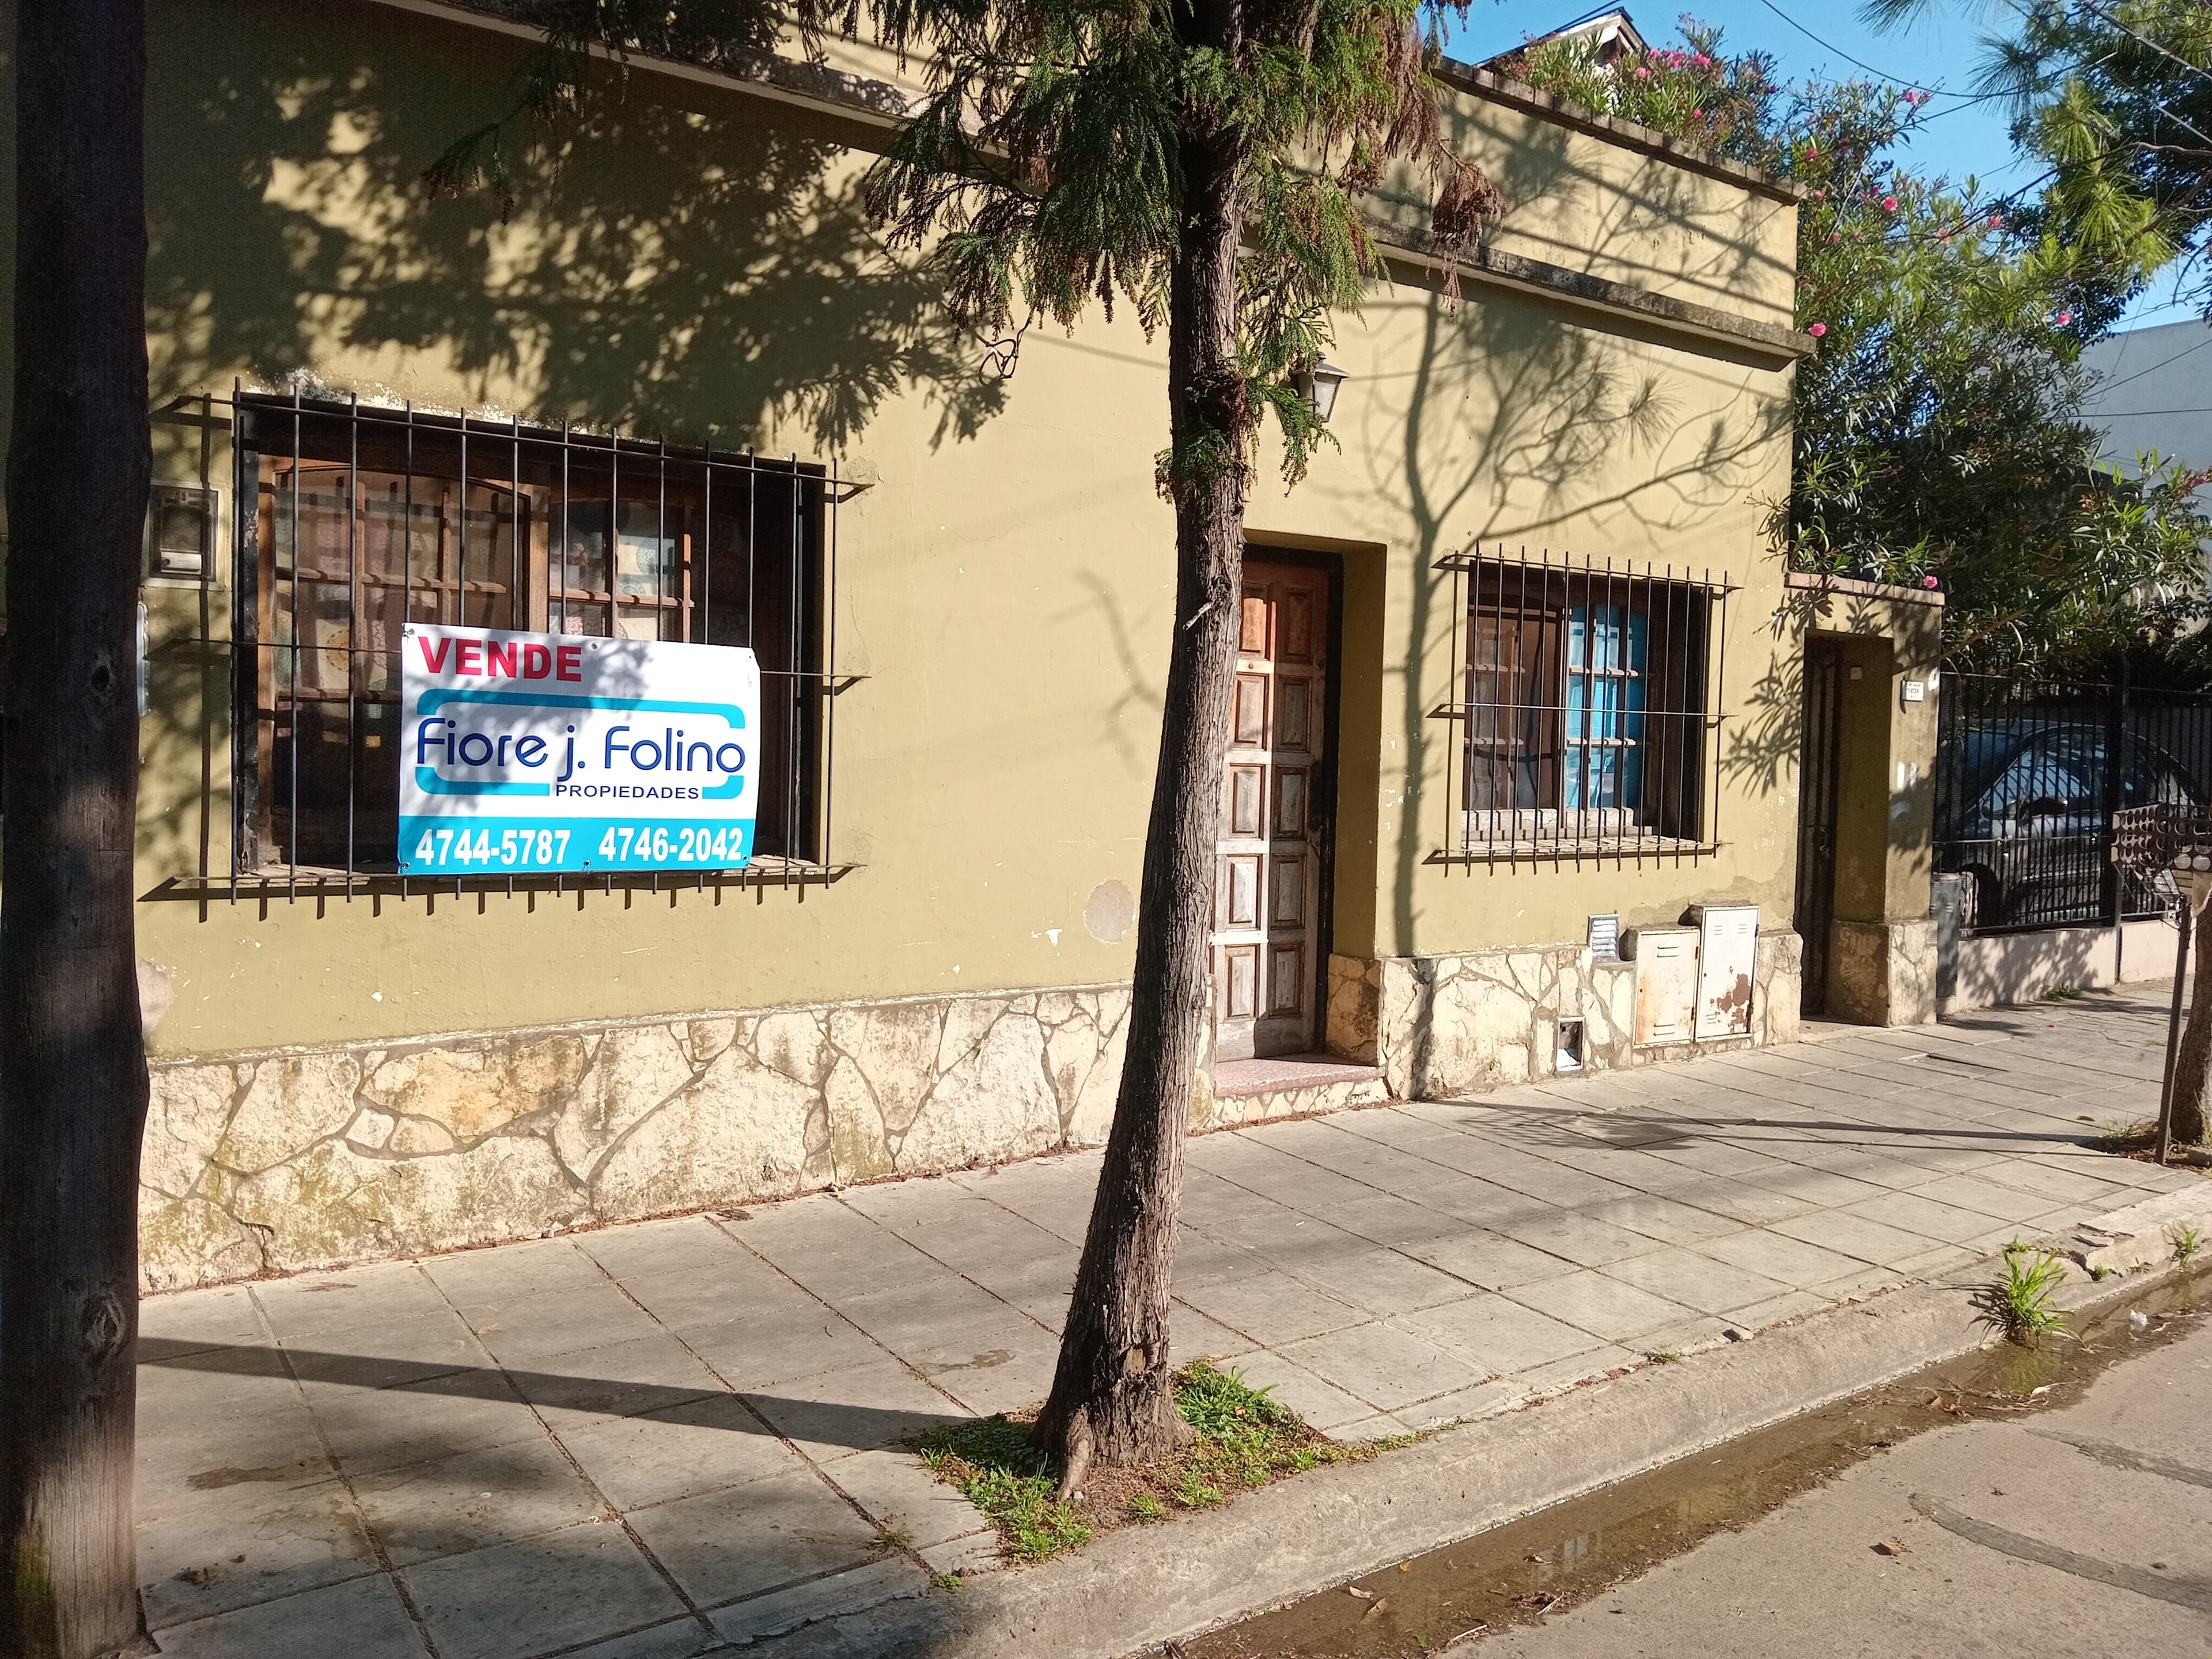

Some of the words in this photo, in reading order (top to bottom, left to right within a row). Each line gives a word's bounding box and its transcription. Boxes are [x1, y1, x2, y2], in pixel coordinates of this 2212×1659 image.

[418, 636, 582, 681] VENDE
[416, 717, 548, 768] Fiore
[556, 725, 585, 782] j.
[604, 726, 746, 773] Folino
[555, 784, 699, 800] PROPIEDADES
[415, 828, 571, 866] 4744-5787
[598, 827, 744, 862] 4746-2042
